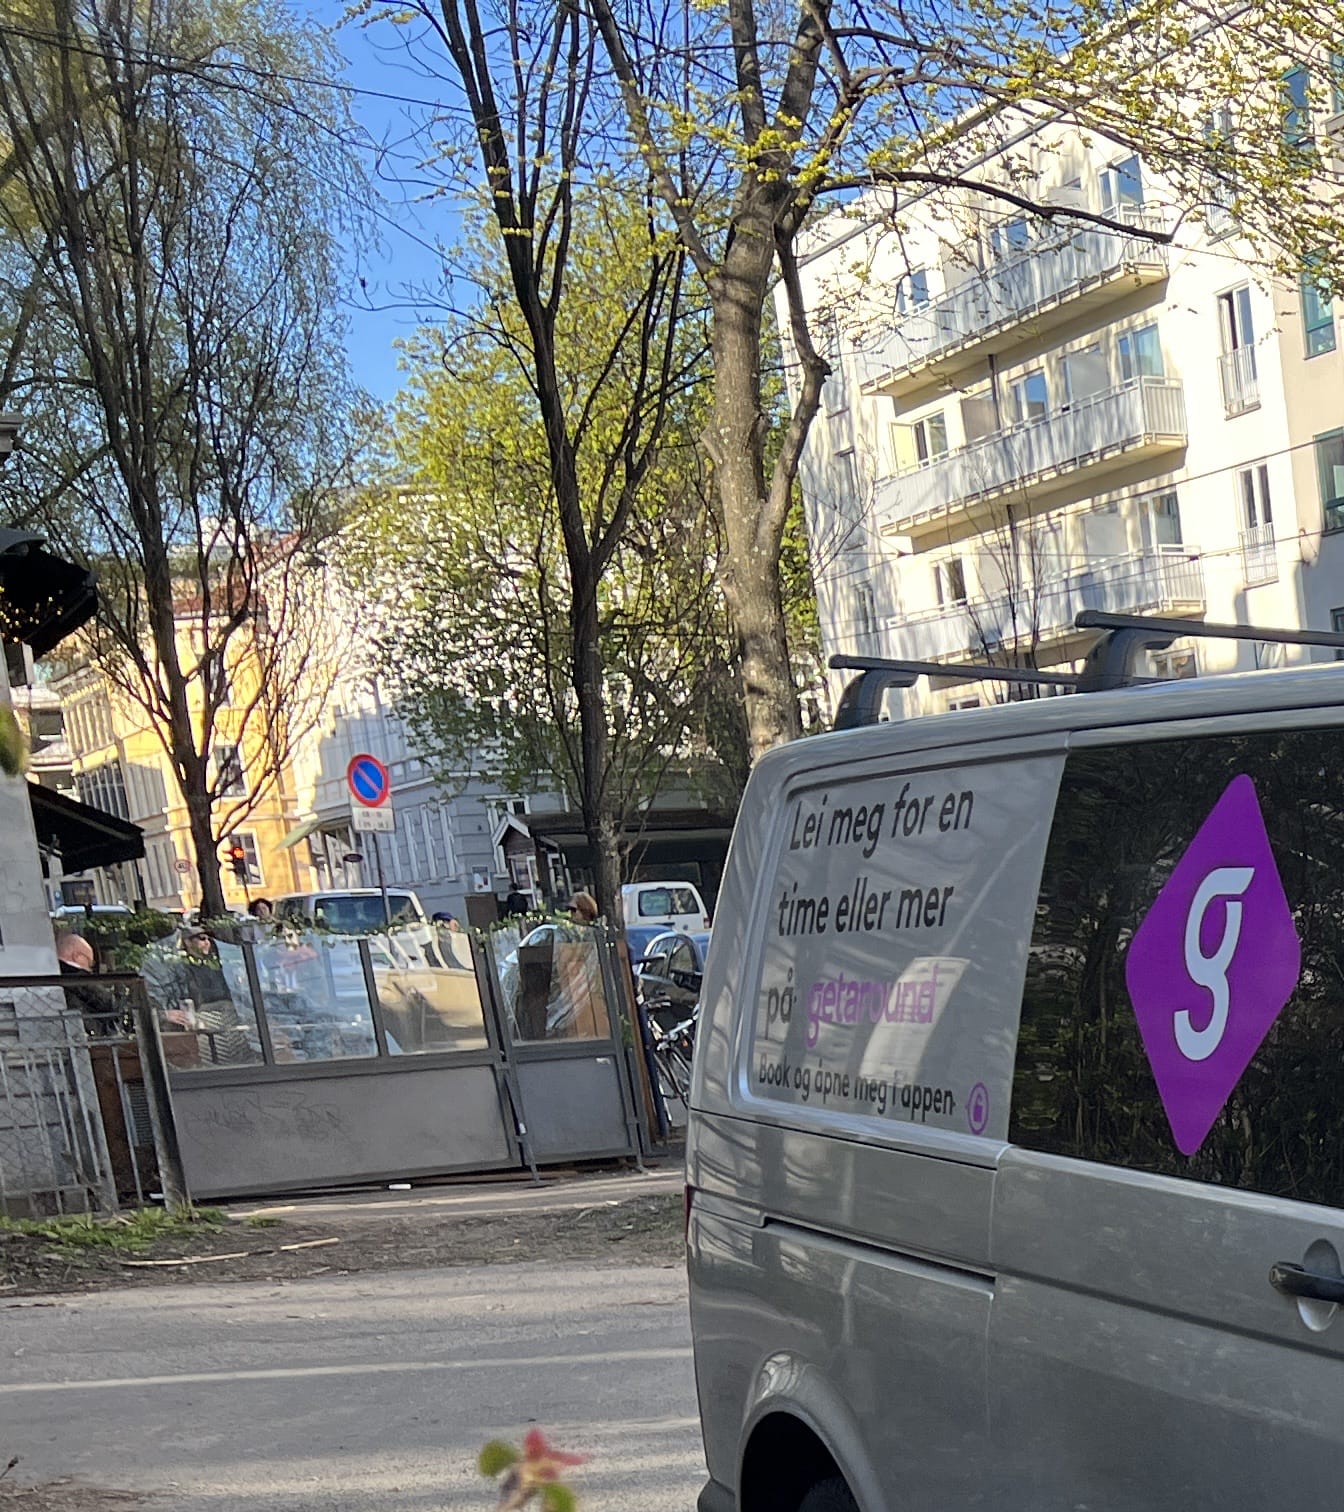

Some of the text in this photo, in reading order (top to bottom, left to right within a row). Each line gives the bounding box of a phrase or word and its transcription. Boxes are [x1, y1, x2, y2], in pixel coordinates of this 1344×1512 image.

[790, 782, 974, 859] Lei meg for en
[778, 877, 954, 936] time eller mer
[765, 963, 939, 1049] på getaround
[759, 1053, 790, 1087] Book
[794, 1069, 811, 1101] og
[814, 1062, 849, 1099] åpne
[853, 1076, 888, 1115] meg
